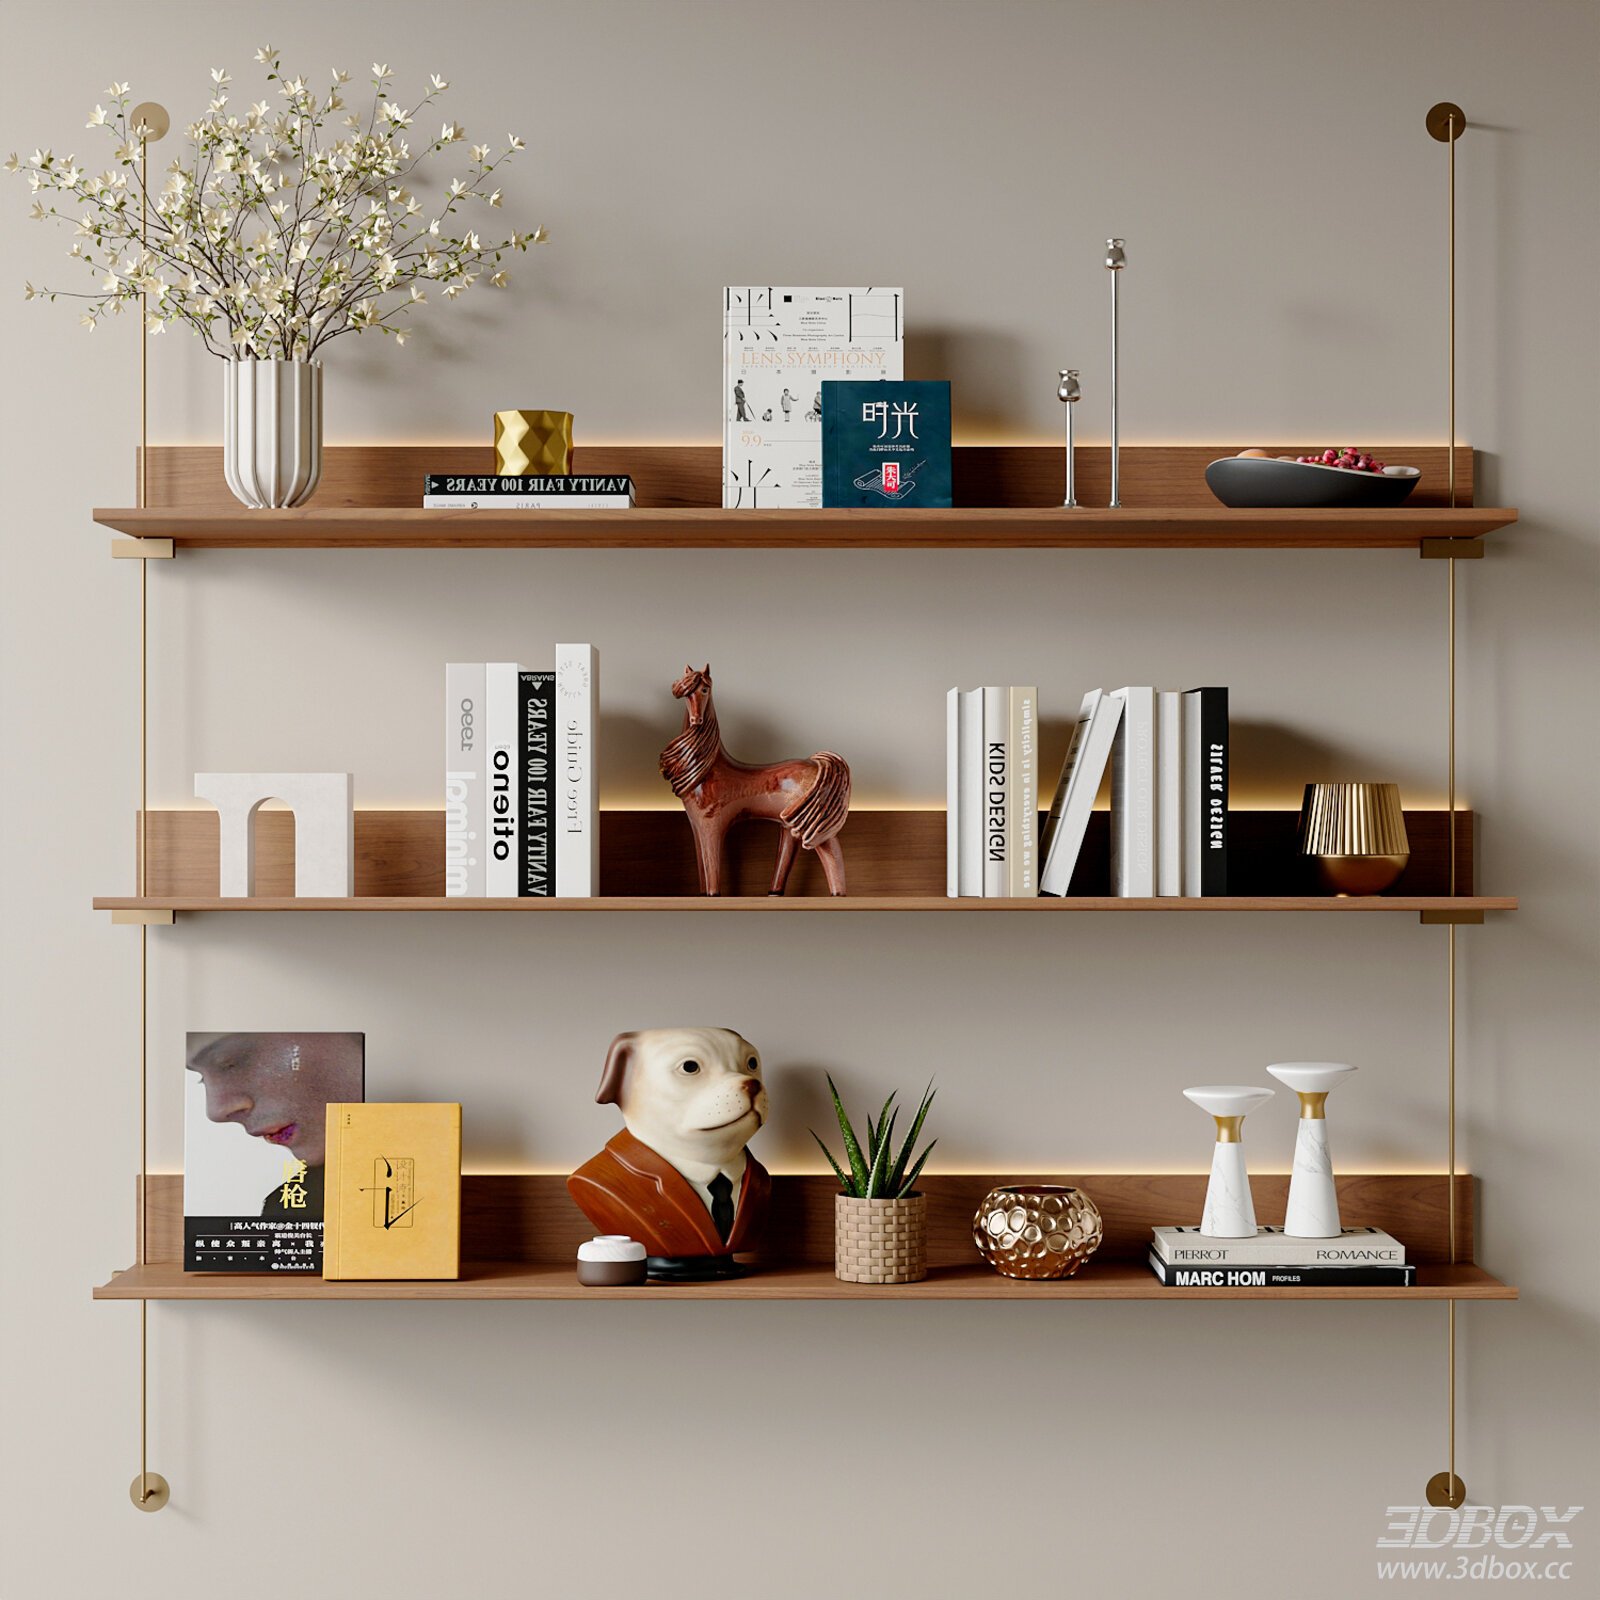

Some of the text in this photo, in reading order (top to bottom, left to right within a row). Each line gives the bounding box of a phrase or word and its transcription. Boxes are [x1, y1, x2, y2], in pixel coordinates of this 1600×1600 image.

[741, 352, 886, 365] LENS SYMPHONY
[1174, 1249, 1229, 1260] PIERROT
[1316, 1249, 1398, 1261] ROMANCE
[1175, 1270, 1301, 1286] MARC HOM PROFILES
